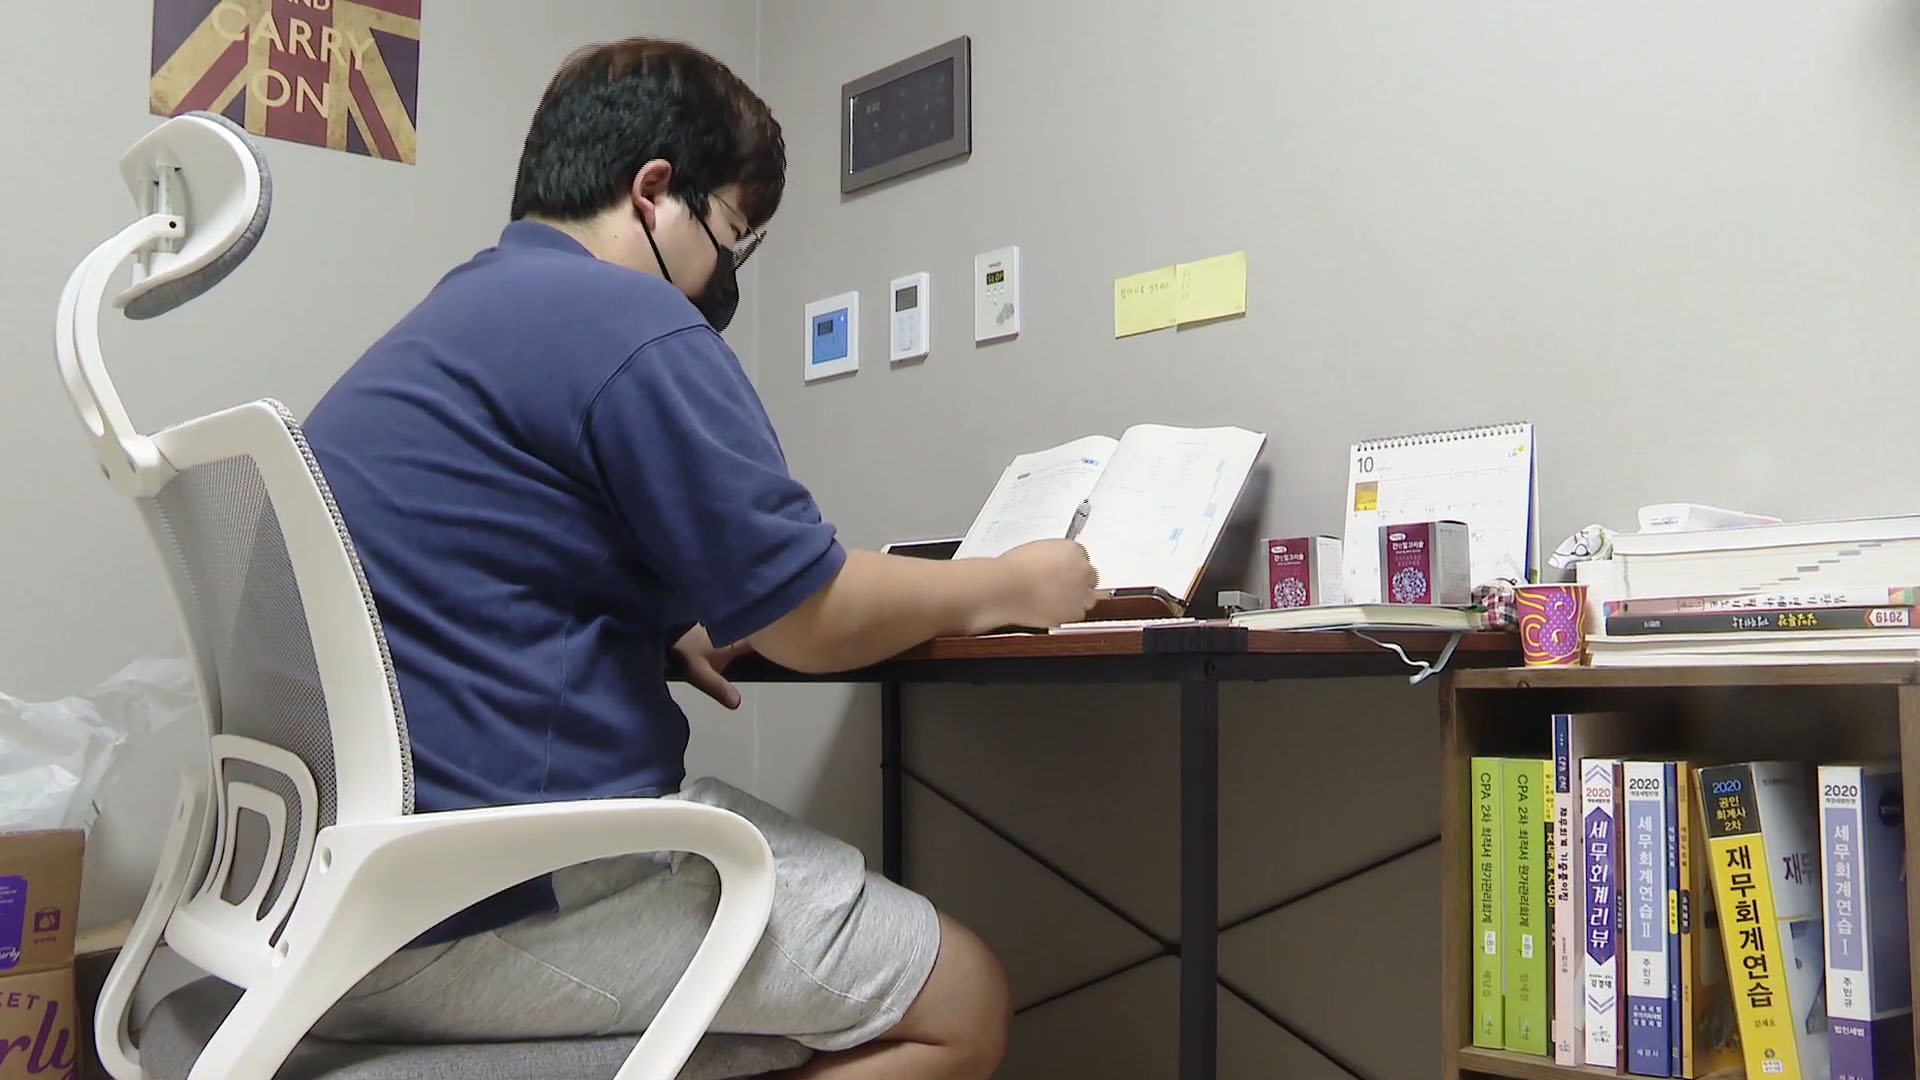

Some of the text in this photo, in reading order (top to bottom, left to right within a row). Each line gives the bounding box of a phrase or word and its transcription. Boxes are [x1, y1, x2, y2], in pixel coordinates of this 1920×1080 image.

[212, 4, 375, 70] CARRY
[250, 69, 331, 118] ON
[1357, 456, 1374, 473] 10
[1875, 611, 1903, 624] 2019
[1480, 772, 1491, 800] CPA
[1517, 774, 1528, 802] CPA
[1586, 788, 1611, 797] 2020
[1629, 778, 1660, 790] 2020
[1712, 780, 1742, 794] 2020
[1824, 784, 1858, 797] 2020
[1718, 795, 1740, 808] 공인
[1481, 804, 1492, 823] 2차
[1518, 806, 1529, 825] 2차
[1716, 807, 1747, 820] 회계사
[1724, 820, 1742, 831] 2차
[1638, 815, 1654, 920] 세무회계연습
[1589, 820, 1609, 949] 세무회계리뷰
[1833, 824, 1853, 936] 세무회계연습
[1482, 862, 1493, 923] 원가관리회계
[1518, 866, 1530, 927] 원가관리회계
[1726, 844, 1774, 1009] 재무회계연습
[0, 992, 40, 1011] ET
